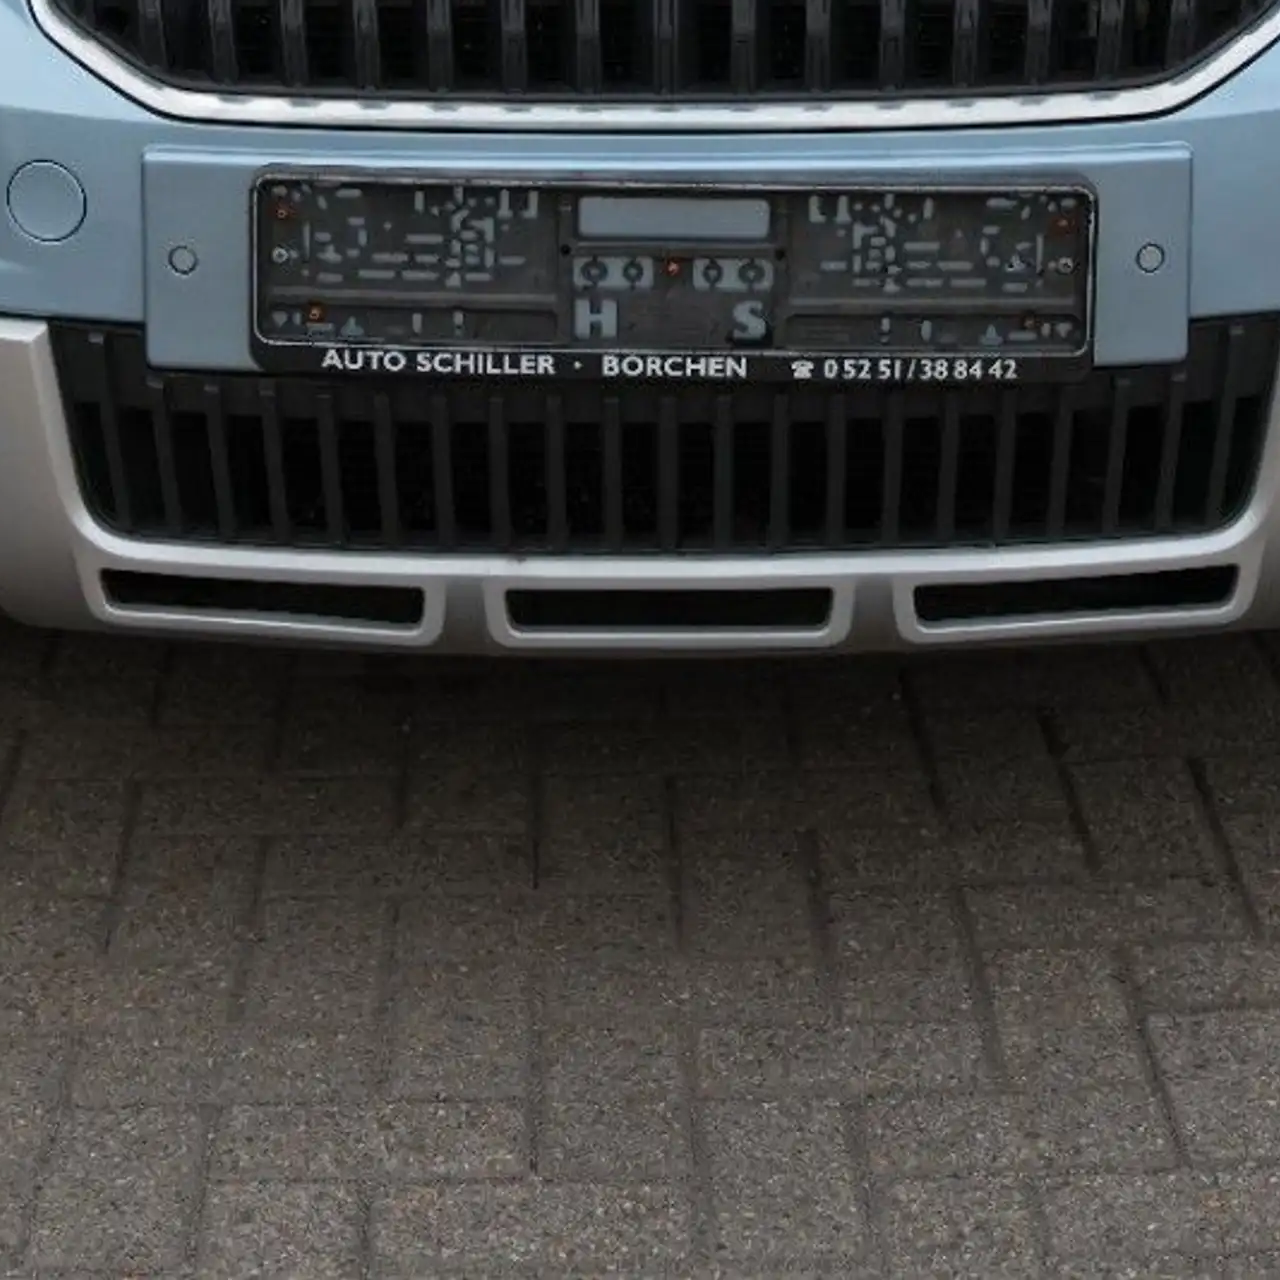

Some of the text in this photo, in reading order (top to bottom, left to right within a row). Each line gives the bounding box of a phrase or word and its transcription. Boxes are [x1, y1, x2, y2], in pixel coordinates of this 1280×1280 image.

[321, 349, 407, 371] AUTO
[416, 352, 556, 375] SCHILLER
[602, 355, 748, 378] BORCHEN
